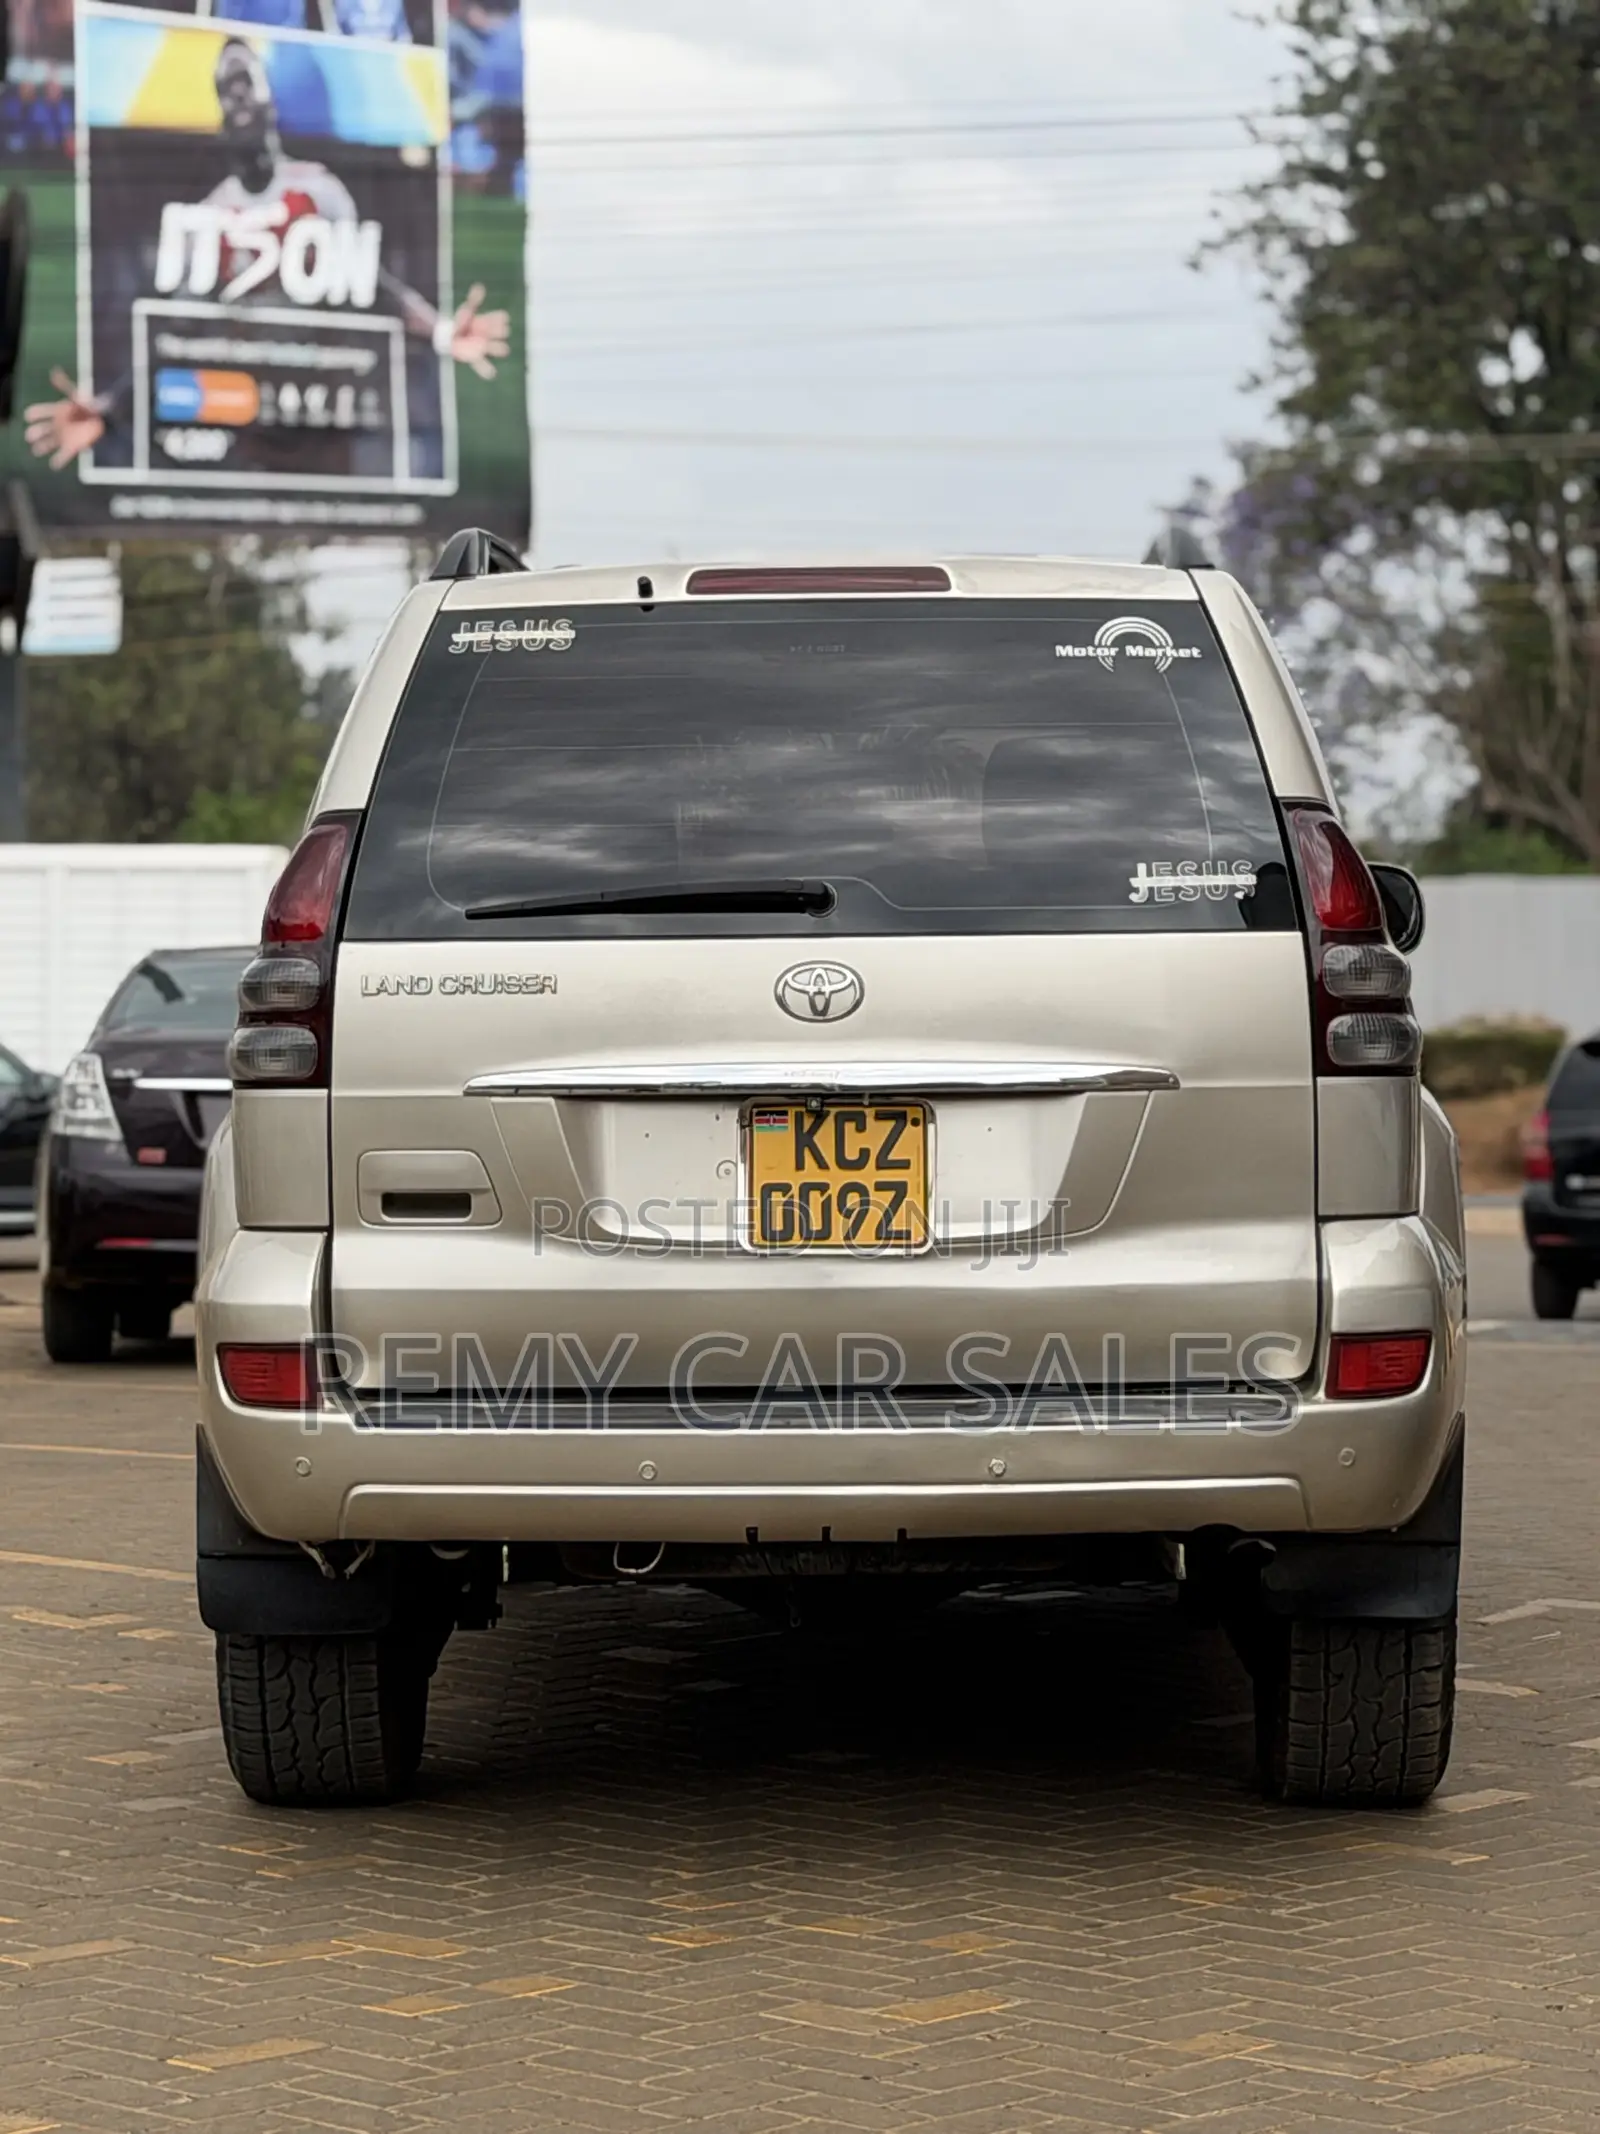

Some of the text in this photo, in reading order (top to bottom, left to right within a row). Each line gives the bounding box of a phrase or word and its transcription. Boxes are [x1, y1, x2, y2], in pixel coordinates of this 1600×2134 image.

[449, 618, 576, 654] JESUS
[1055, 644, 1202, 658] Motor Market
[1128, 859, 1257, 903] JESUS
[361, 973, 558, 997] LAND CRUISER
[794, 1109, 911, 1171] KCZ
[760, 1180, 912, 1242] 009Z
